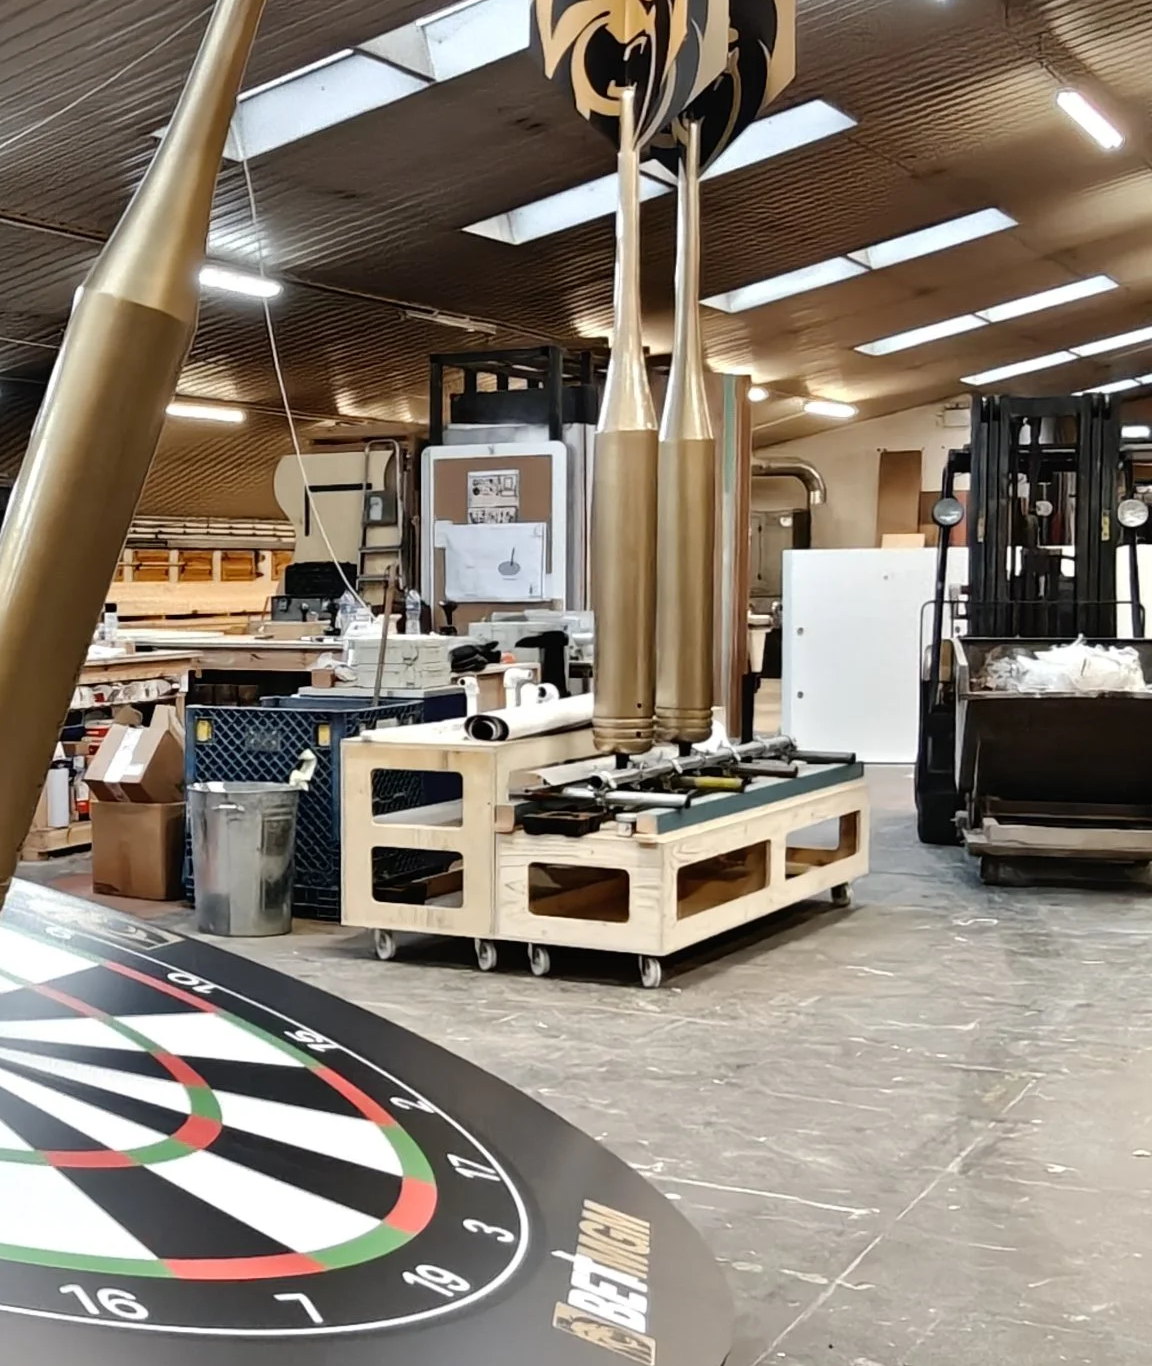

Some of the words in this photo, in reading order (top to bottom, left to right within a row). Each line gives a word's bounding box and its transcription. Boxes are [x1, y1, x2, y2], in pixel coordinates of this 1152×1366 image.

[167, 972, 217, 994] 10
[284, 1029, 338, 1052] 15
[389, 1096, 435, 1113] 2
[447, 1153, 501, 1181] 17
[462, 1218, 514, 1243] 3
[567, 1199, 650, 1333] BETMGM
[402, 1264, 470, 1297] 19
[59, 1284, 149, 1320] 16
[273, 1293, 324, 1323] 7
